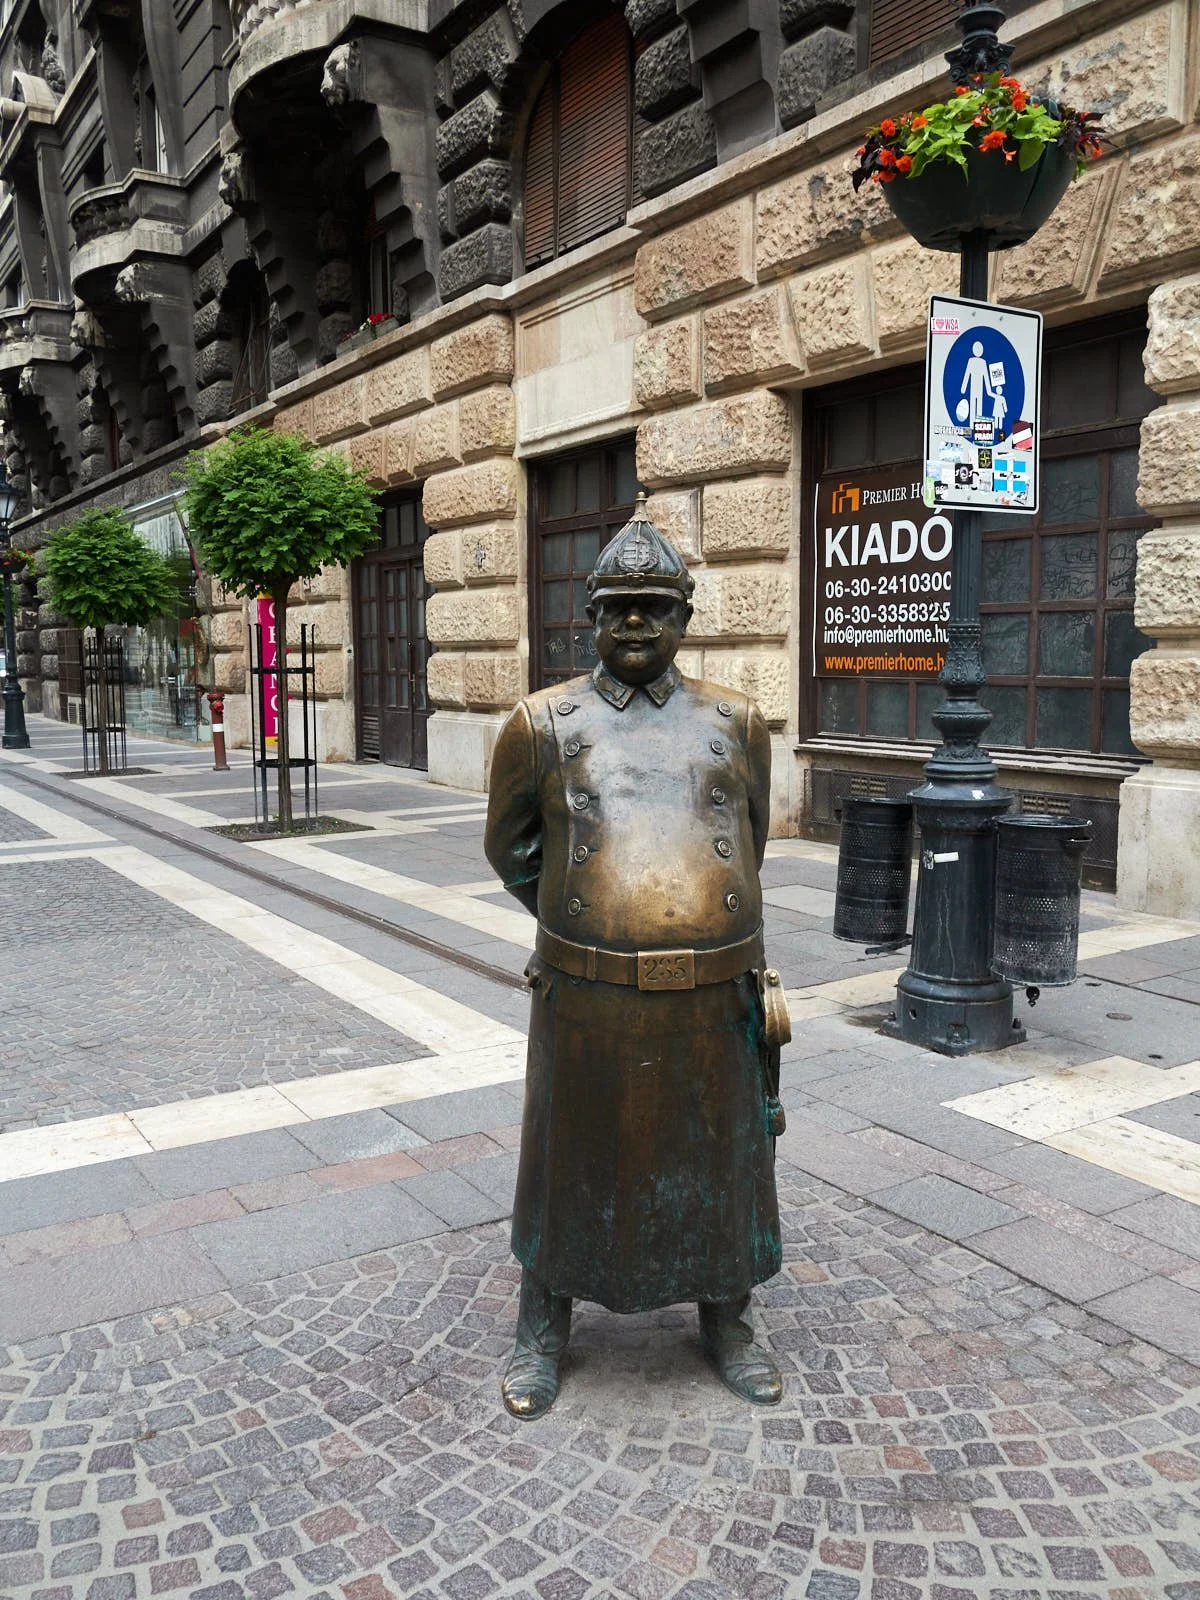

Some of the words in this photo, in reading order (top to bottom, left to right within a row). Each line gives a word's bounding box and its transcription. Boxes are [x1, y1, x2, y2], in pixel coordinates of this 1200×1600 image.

[945, 319, 959, 330] WSA
[862, 485, 906, 506] PREMIER
[825, 506, 952, 568] KIADÓ
[824, 601, 950, 624] 06-30-3358325
[825, 652, 945, 673] www.premierhome.h
